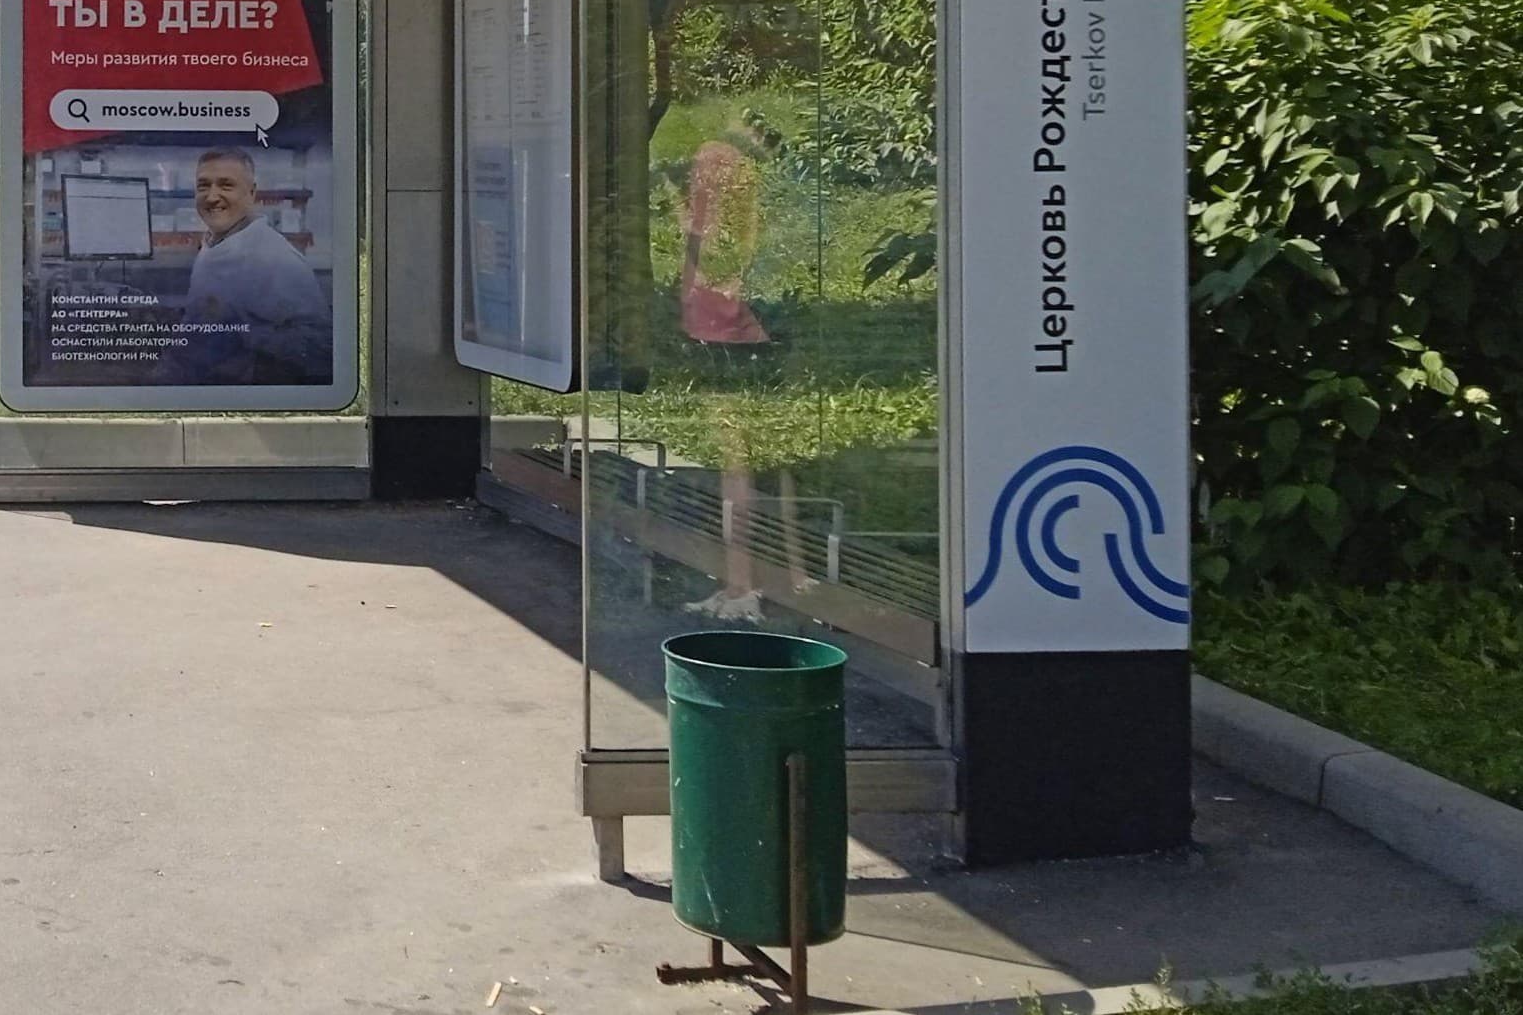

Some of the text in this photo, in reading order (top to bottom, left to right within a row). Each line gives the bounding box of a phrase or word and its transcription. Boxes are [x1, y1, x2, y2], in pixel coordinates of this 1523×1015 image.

[49, 0, 278, 34] ТЫ В ДЕЛЕ?
[51, 49, 309, 67] Меры развития твоего бизнеса
[1081, 11, 1107, 121] Tserkov
[102, 101, 251, 118] moscow.business
[1034, 183, 1075, 373] Церковь
[52, 295, 159, 305] КОНСТАНТИН СЕРЕДА
[51, 310, 128, 318] АО «ГЕНТЕРРА»
[52, 324, 250, 333] НА СРЕДСТВА ГРАНТА НА ОБОРУДОВАНИЕ
[52, 338, 189, 346] ОСНАСТИЛИ ЛАБОРАТОРИЮ
[52, 352, 159, 361] БИОТЕХНОЛОГИИ РНК
